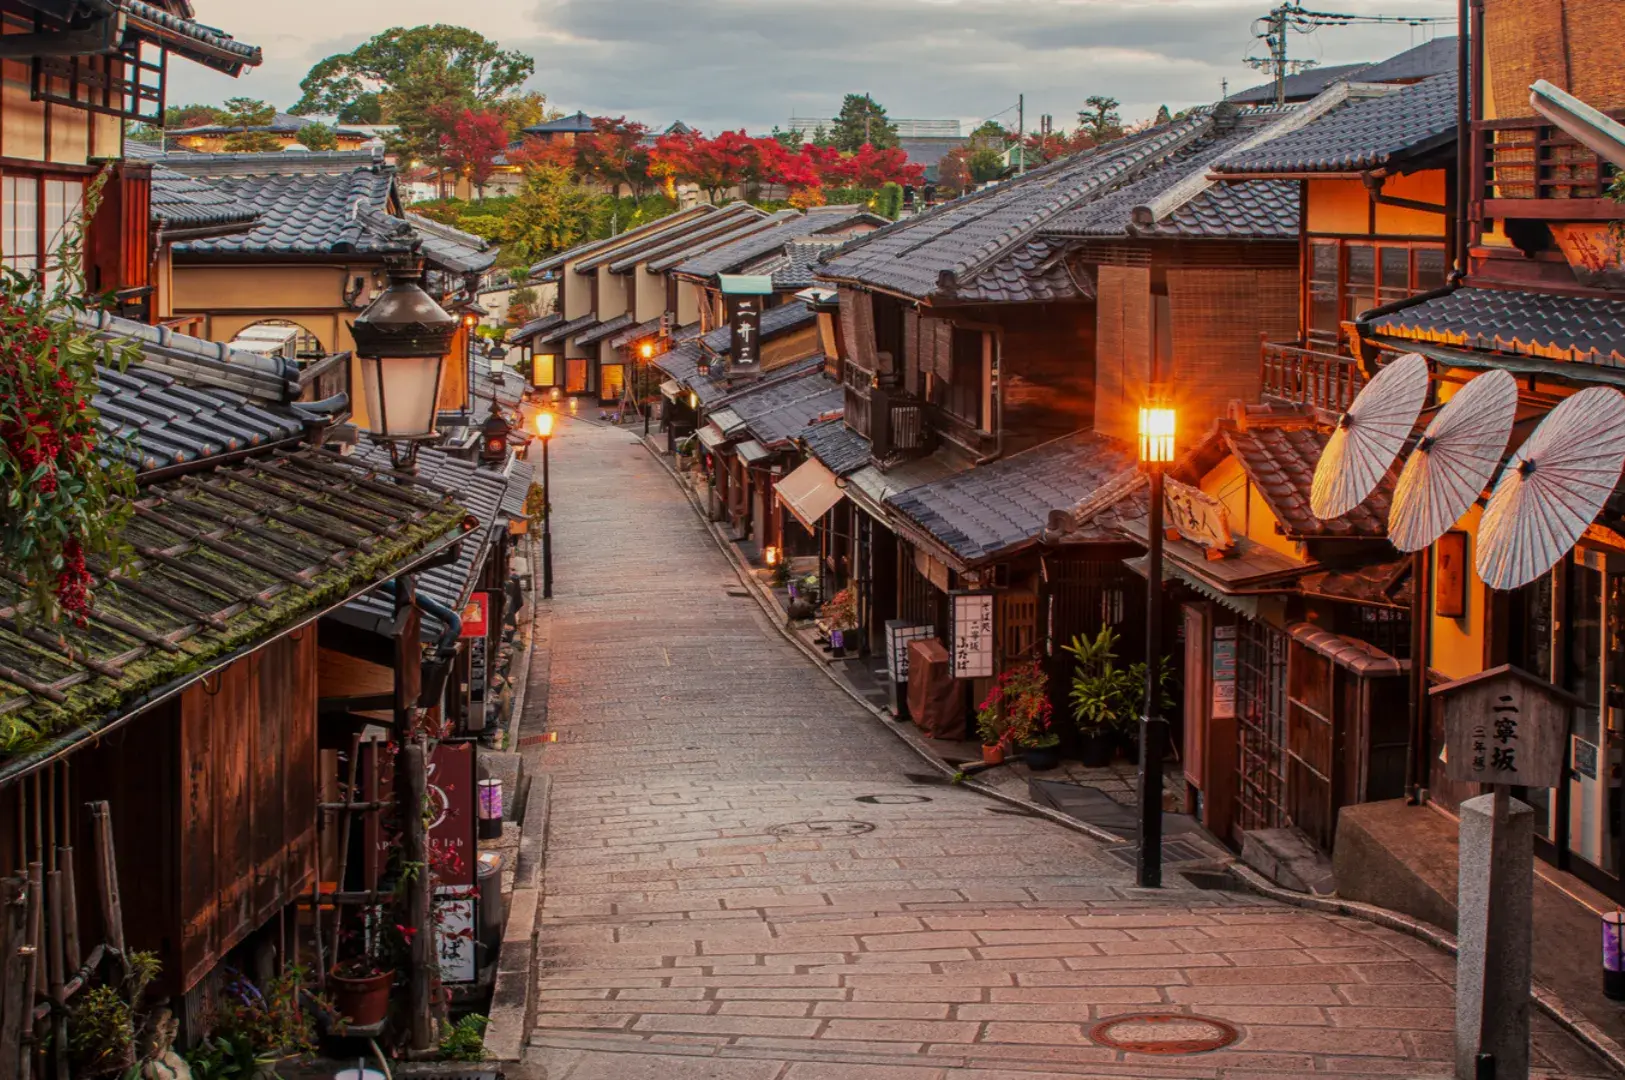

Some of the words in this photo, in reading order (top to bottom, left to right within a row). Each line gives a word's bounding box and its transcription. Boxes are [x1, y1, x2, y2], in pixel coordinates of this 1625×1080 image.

[736, 301, 757, 364] 二井三
[957, 636, 969, 670] ふたば
